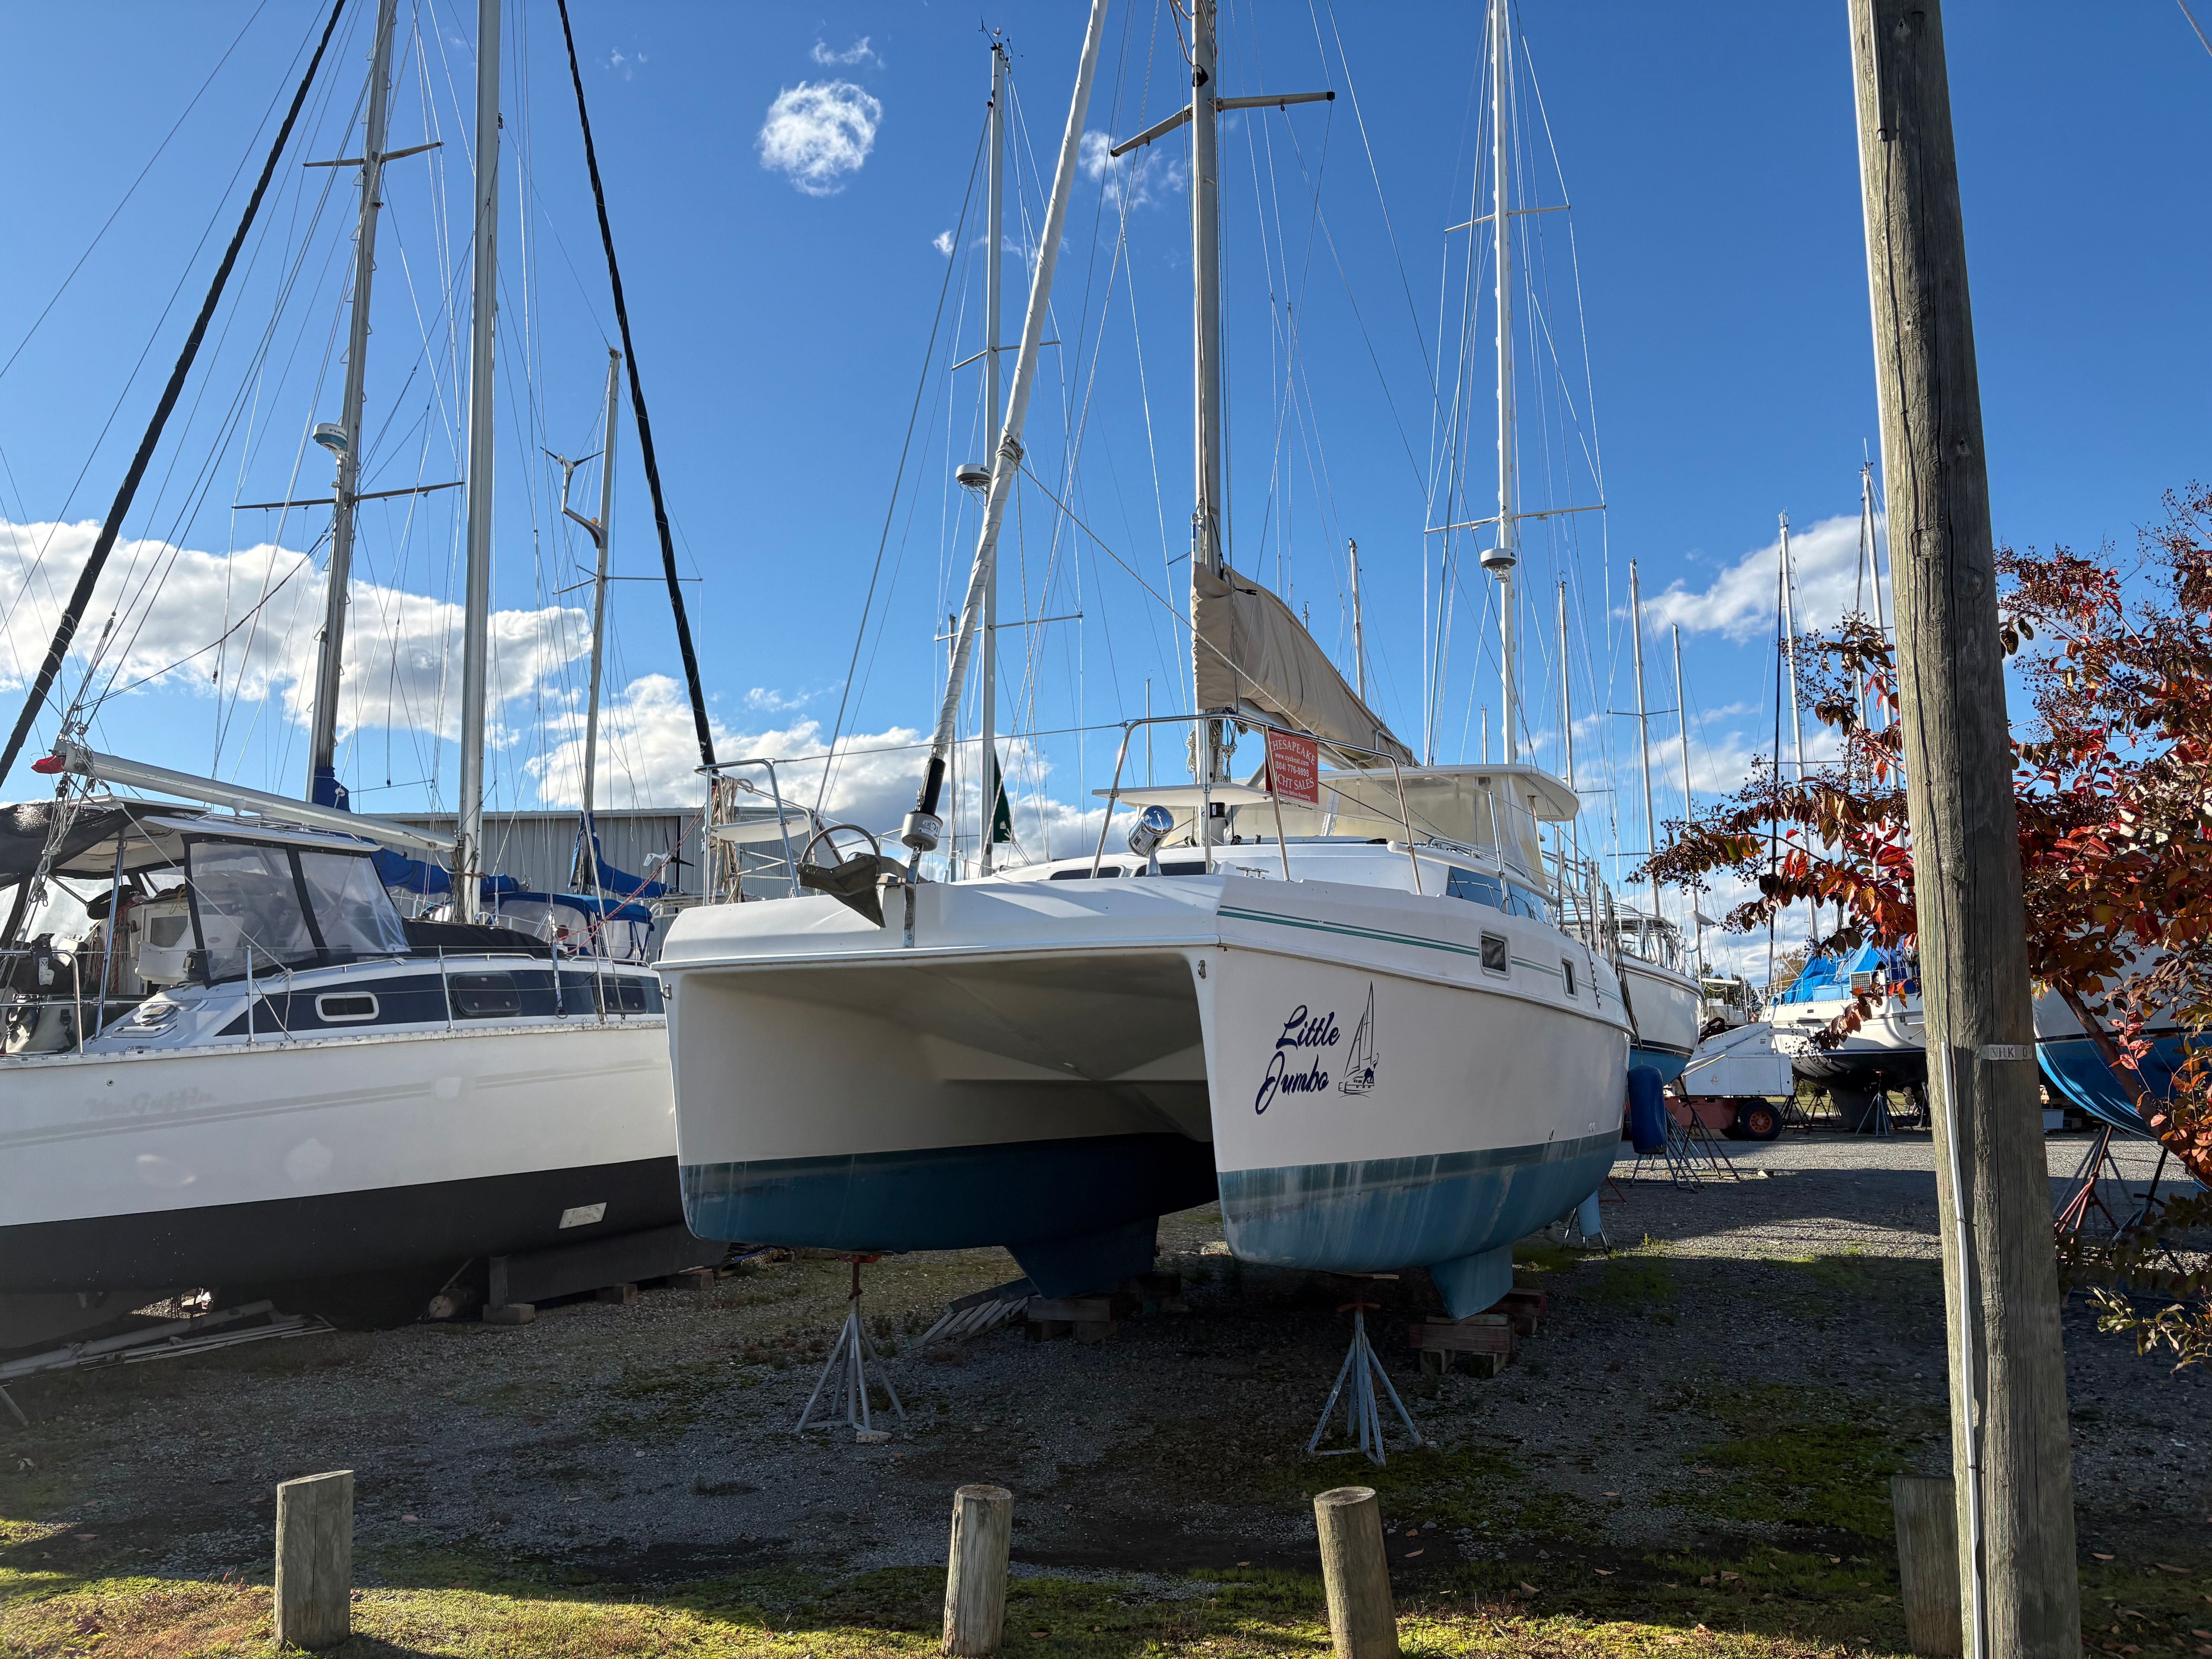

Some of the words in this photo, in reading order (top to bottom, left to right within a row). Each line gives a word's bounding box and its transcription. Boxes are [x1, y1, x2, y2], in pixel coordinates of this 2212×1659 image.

[1274, 761, 1286, 771] (804)
[1275, 771, 1293, 788] CHT
[1294, 777, 1314, 790] SALES
[1276, 1005, 1340, 1050] Little
[1255, 1051, 1329, 1115] Jumbo
